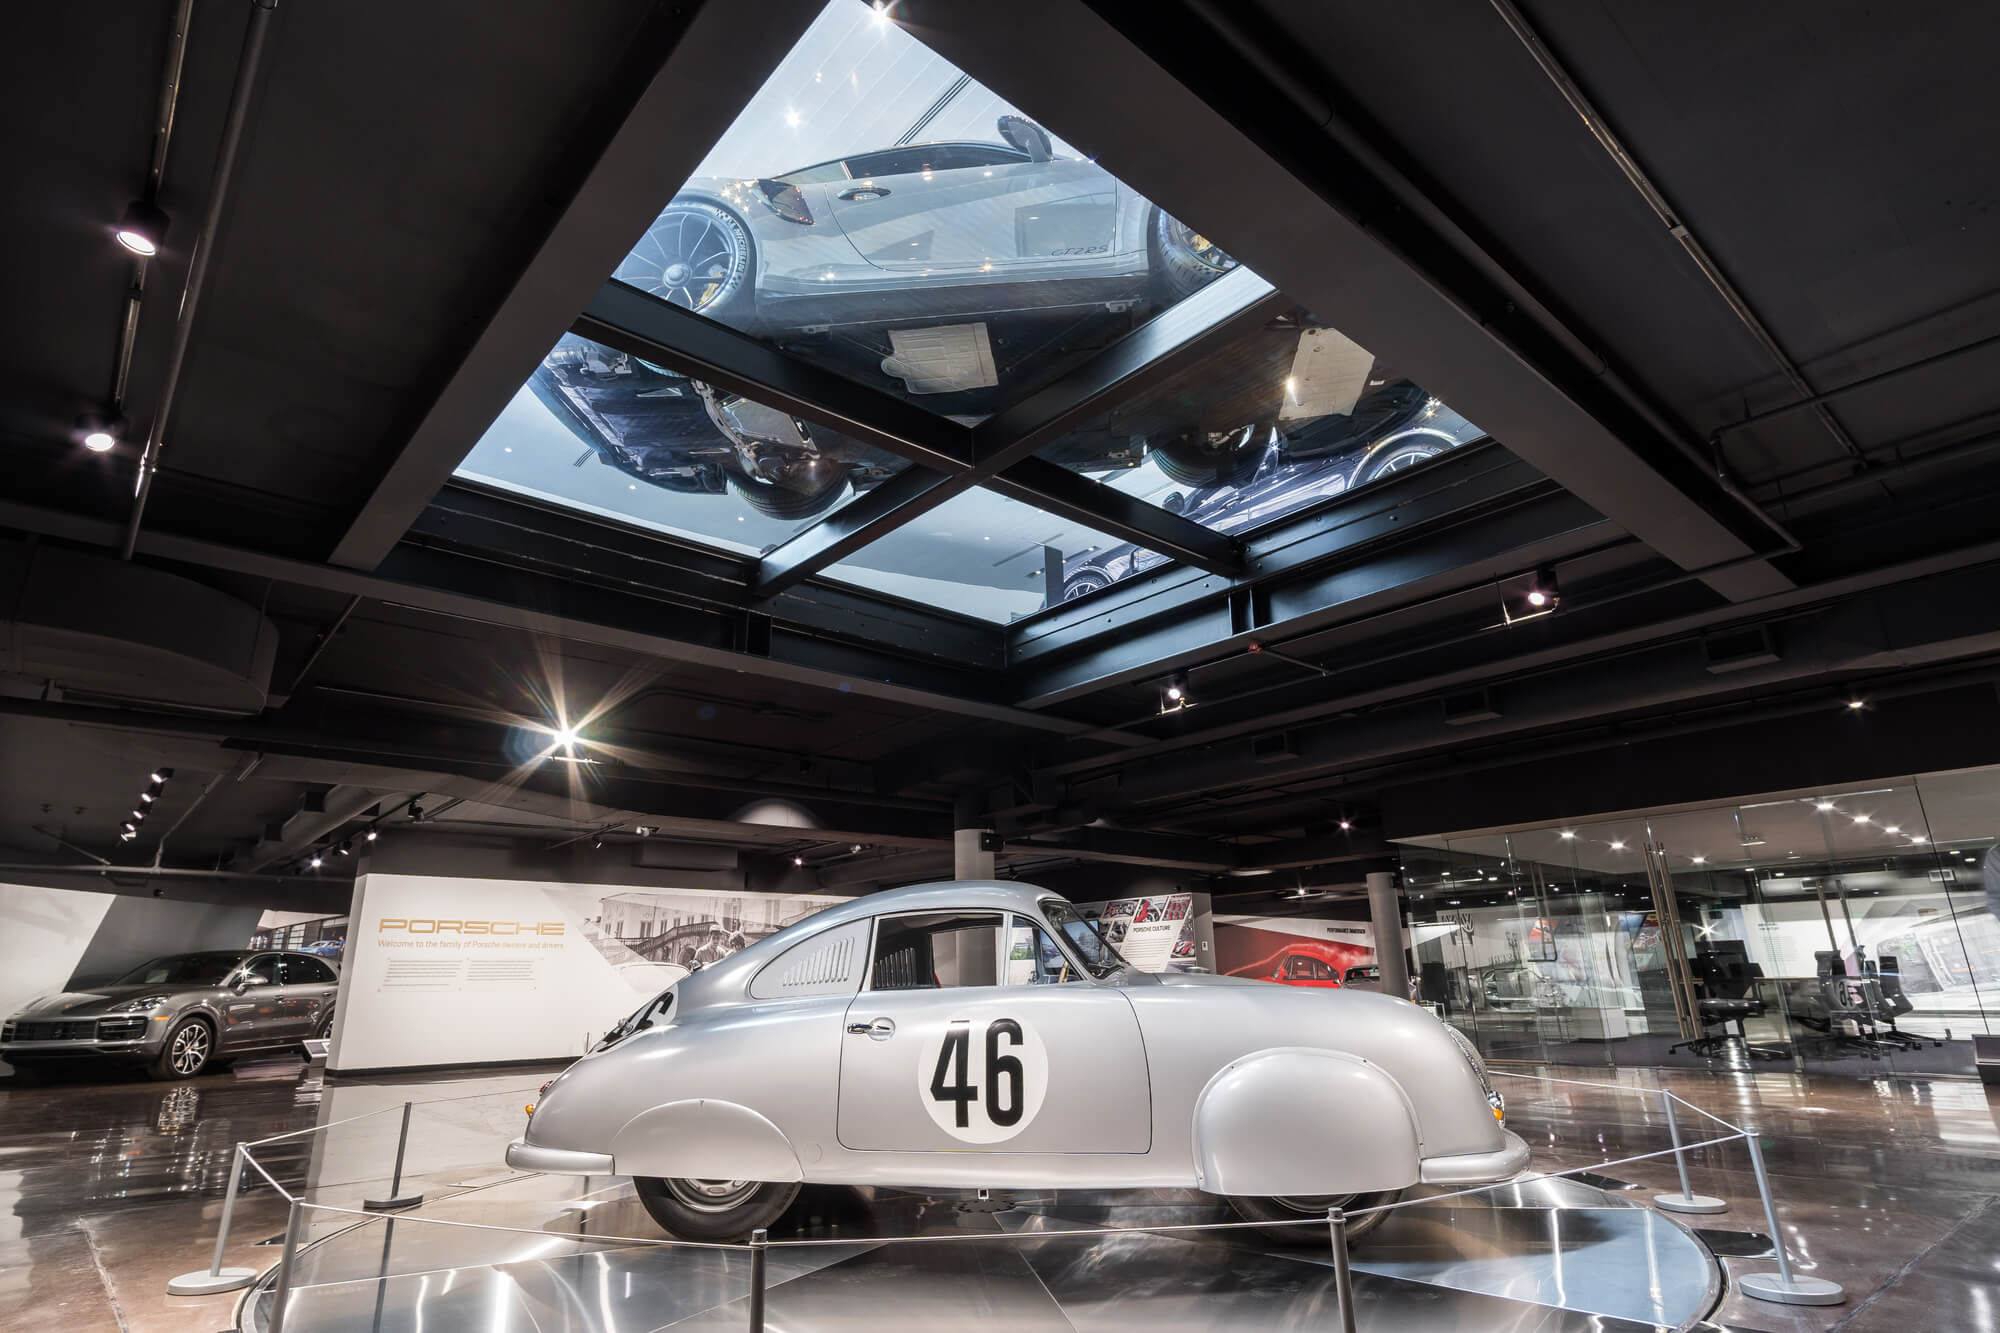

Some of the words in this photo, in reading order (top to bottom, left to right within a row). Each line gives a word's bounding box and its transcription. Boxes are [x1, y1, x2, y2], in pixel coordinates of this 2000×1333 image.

[379, 918, 565, 936] PORSCHE
[1152, 924, 1171, 932] CULTURE
[378, 939, 414, 948] Welcome
[416, 940, 424, 948] to
[426, 939, 437, 948] the
[440, 939, 461, 951] family
[473, 940, 501, 949] Porsche
[930, 1018, 1024, 1128] 46
